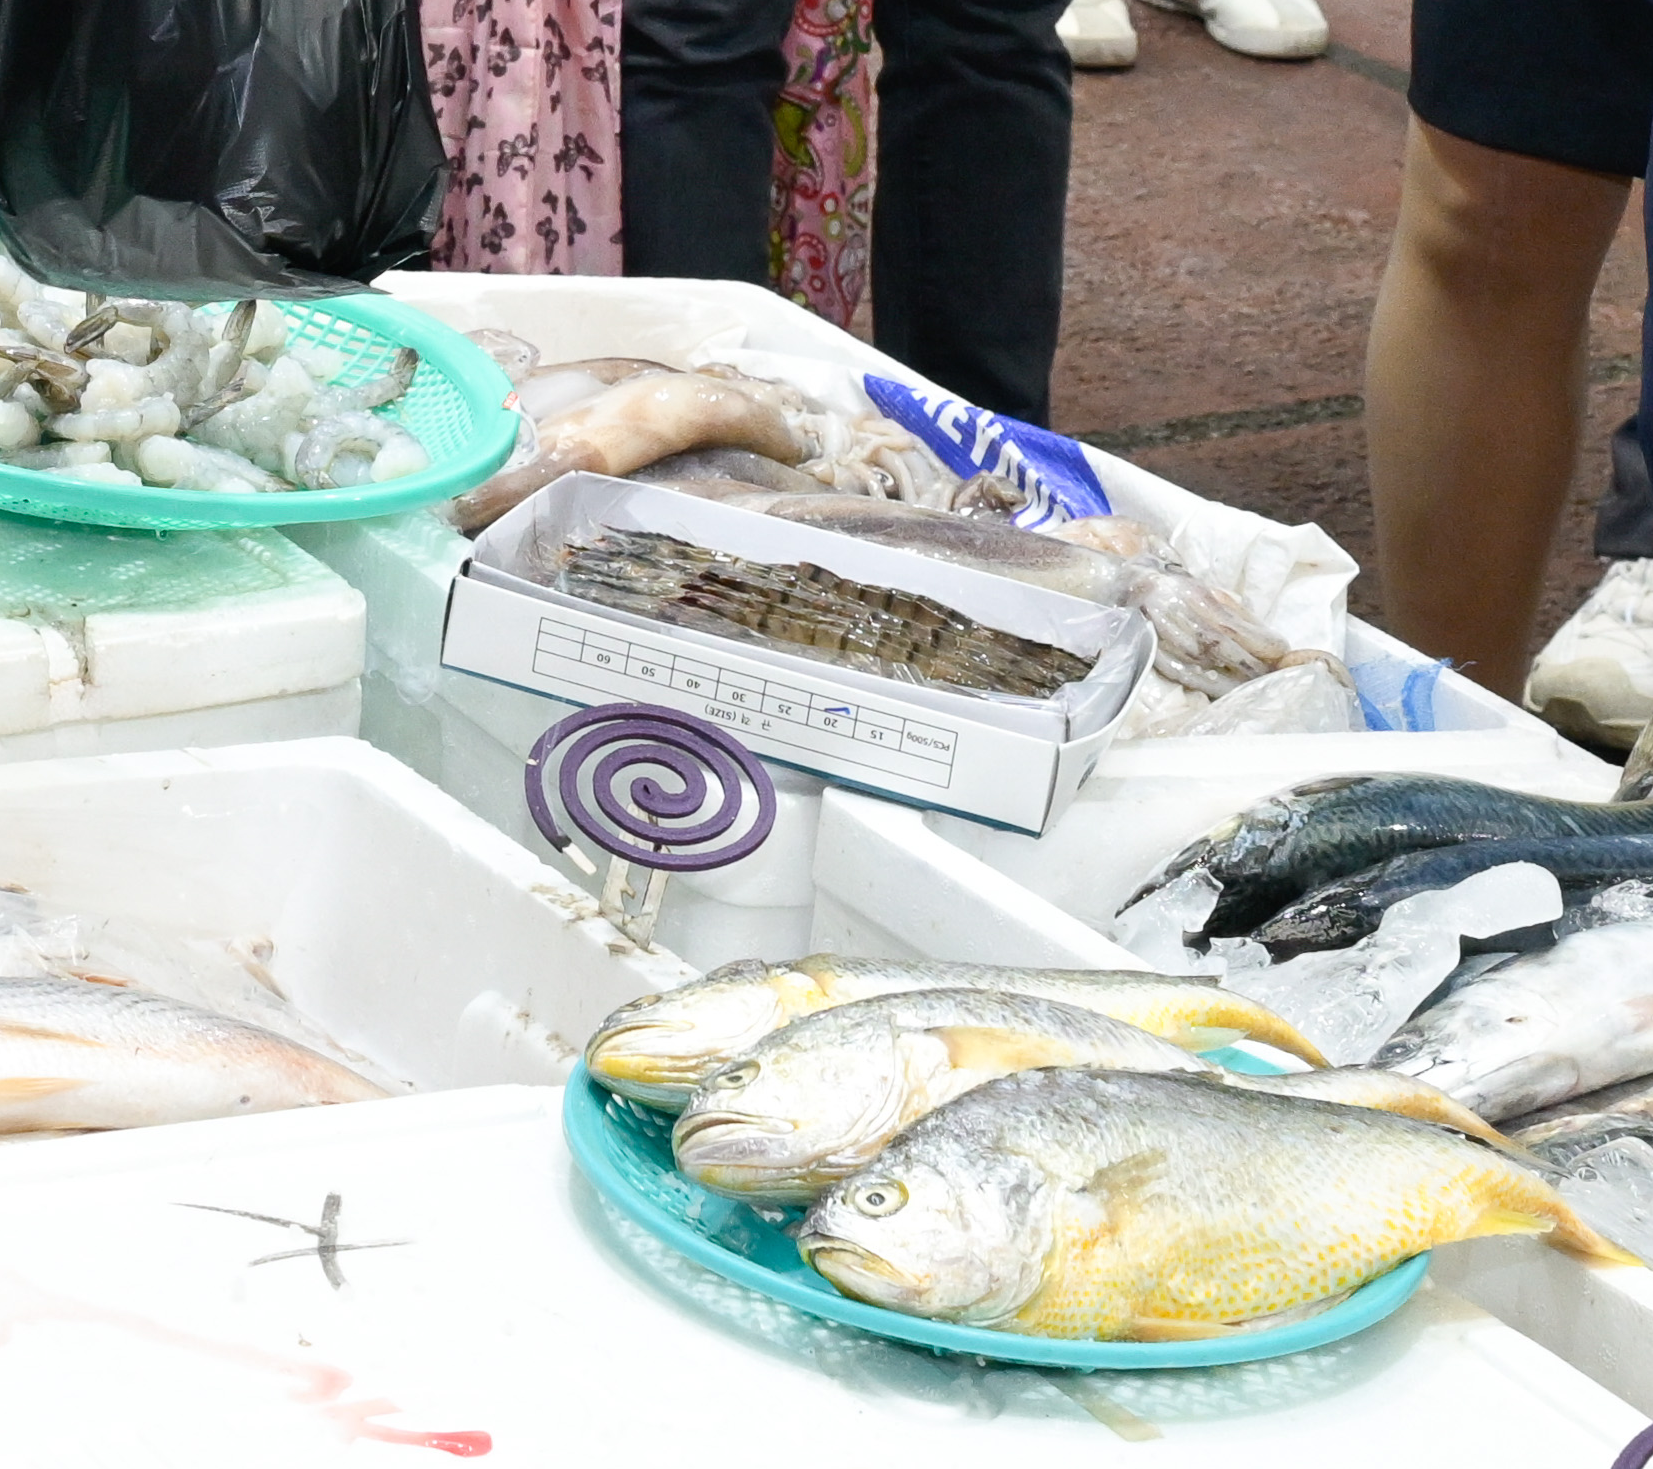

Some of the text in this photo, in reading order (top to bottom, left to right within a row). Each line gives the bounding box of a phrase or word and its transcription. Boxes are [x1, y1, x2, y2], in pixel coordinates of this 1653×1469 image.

[596, 652, 612, 665] 60
[640, 665, 656, 677] 50
[686, 677, 701, 690] 40
[731, 691, 747, 703] 30
[703, 703, 736, 724] (SIZE)
[777, 703, 793, 716] 25
[823, 716, 839, 729] 20
[869, 729, 885, 742] 15
